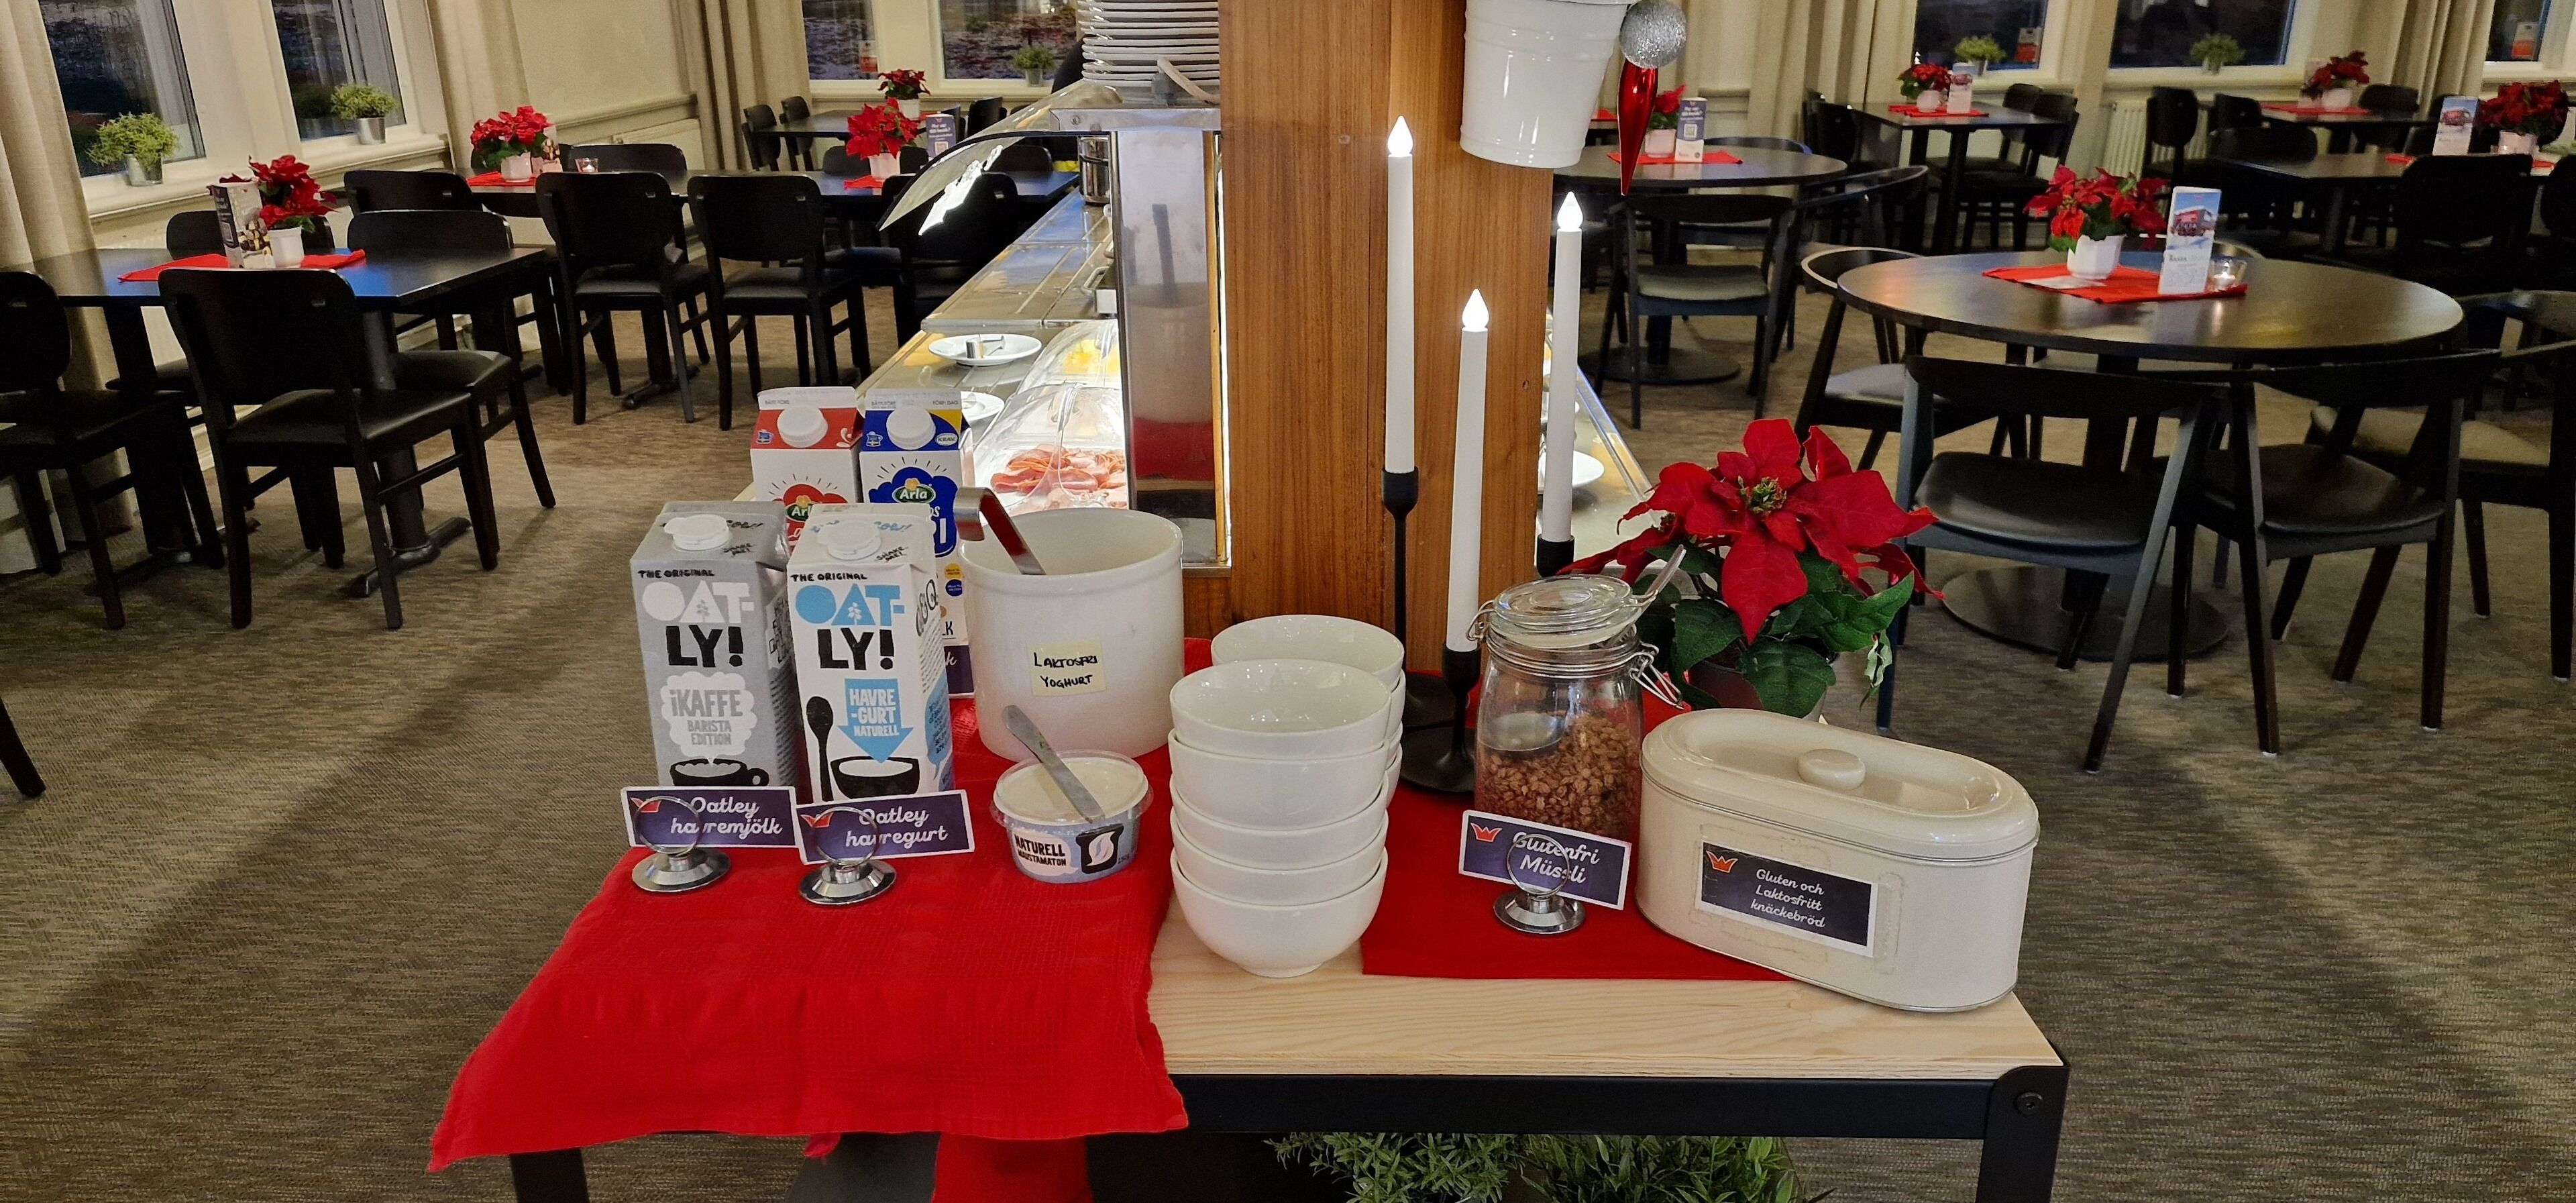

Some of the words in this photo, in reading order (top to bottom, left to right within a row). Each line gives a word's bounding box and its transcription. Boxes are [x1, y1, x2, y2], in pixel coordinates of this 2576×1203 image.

[900, 486, 927, 500] Arla
[792, 503, 812, 517] Arl
[876, 546, 905, 561] SHAKE
[638, 570, 662, 578] THE
[664, 570, 715, 578] ORIGINAL
[790, 574, 814, 582] THE
[817, 572, 867, 581] ORIGINAL
[642, 580, 755, 623] OAT-
[795, 583, 905, 626] OAT-
[666, 625, 743, 668] LY!
[817, 627, 894, 670] LY!
[1040, 674, 1093, 688] YOGHURT
[669, 689, 743, 717] iKAFFE
[849, 688, 896, 706] HAVRE
[687, 720, 732, 732] BARISTA
[851, 707, 896, 724] -GURT
[691, 733, 732, 745] EDITION
[853, 725, 899, 737] NATURELL
[691, 796, 760, 819] Oatley
[859, 806, 930, 828] Oatley
[845, 826, 949, 849] havregurt
[1014, 834, 1066, 857] NATURELL
[1513, 831, 1601, 864] Glutenfri
[1018, 849, 1067, 867] MAUSTAMATON
[1519, 855, 1587, 884] Müssli
[1756, 869, 1799, 889] Gluten
[1801, 882, 1825, 895] och
[1755, 885, 1823, 911] Laktosfritt
[1750, 899, 1826, 928] knäckebröd
